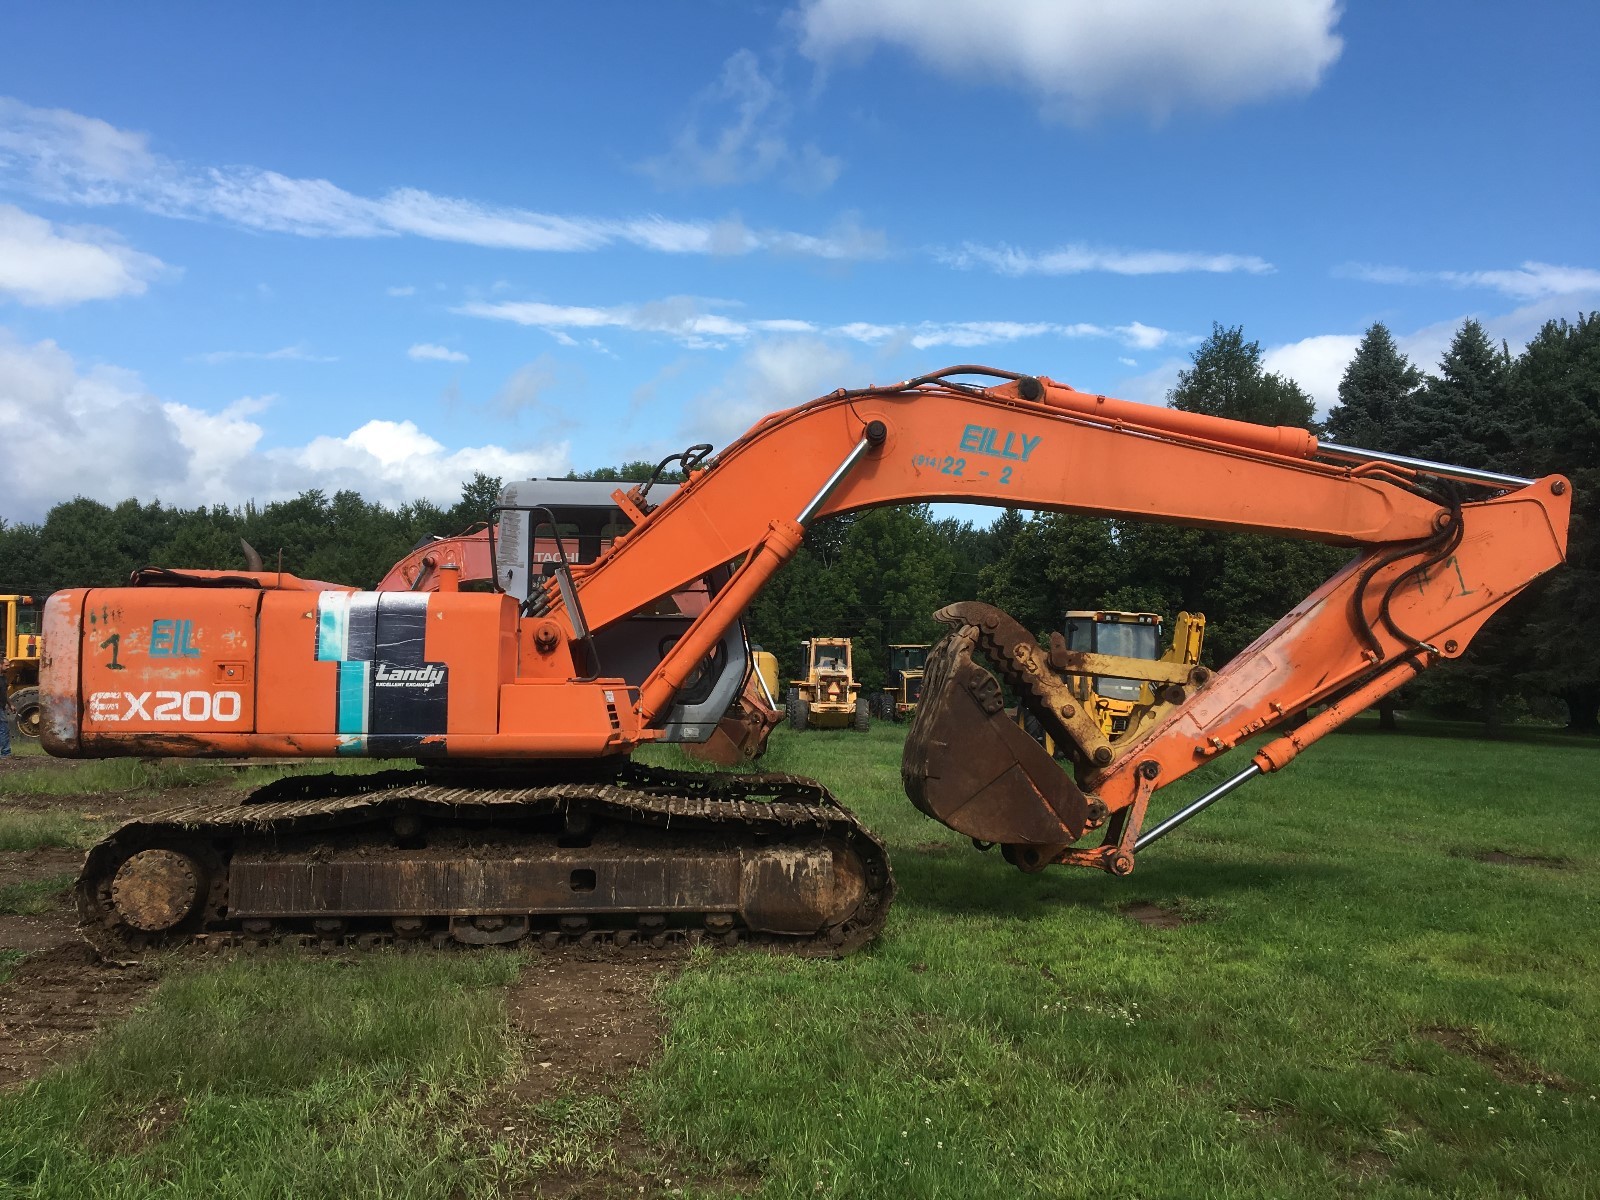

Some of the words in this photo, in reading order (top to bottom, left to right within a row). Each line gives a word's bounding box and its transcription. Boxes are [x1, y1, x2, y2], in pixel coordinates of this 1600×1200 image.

[959, 423, 1043, 462] EILLY
[100, 633, 126, 670] 1
[148, 619, 201, 658] EIL
[375, 664, 445, 684] Landy
[89, 690, 241, 722] EX200
